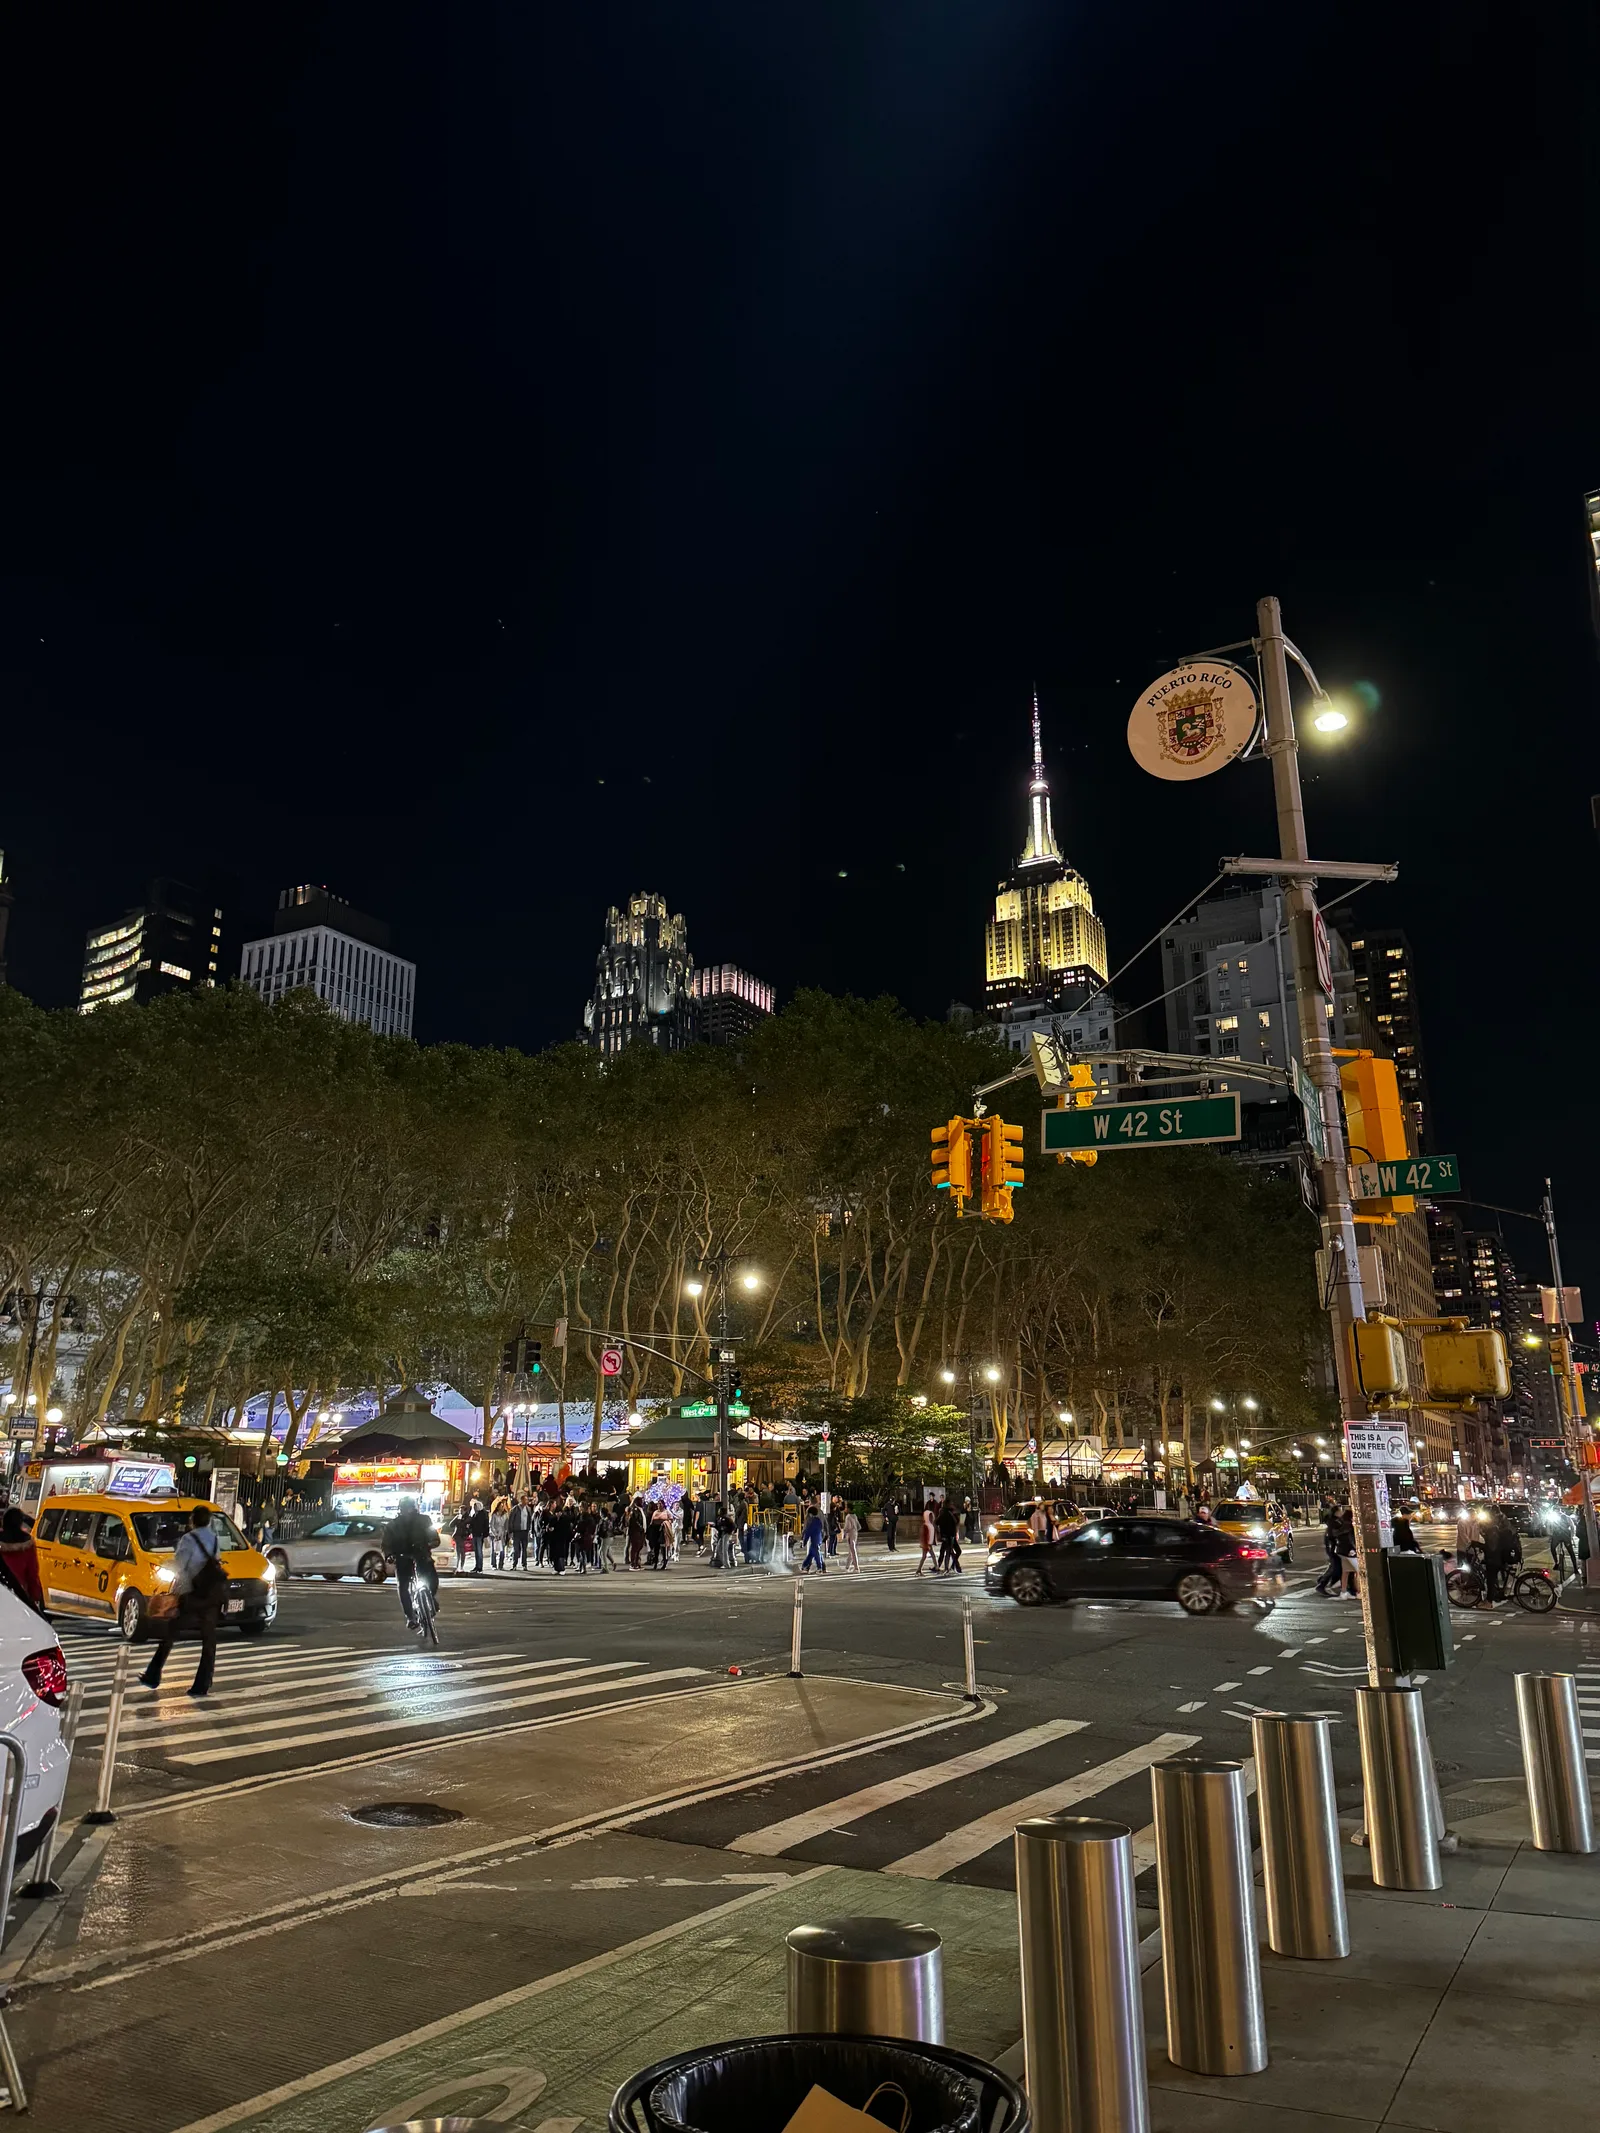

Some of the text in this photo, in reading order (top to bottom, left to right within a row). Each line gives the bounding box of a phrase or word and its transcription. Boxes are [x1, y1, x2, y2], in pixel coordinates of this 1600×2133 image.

[1146, 672, 1232, 707] PUERTO RICO
[1093, 1109, 1183, 1139] W 42 St
[1380, 1161, 1452, 1192] W 42 St
[1584, 1363, 1600, 1372] W 42
[682, 1408, 697, 1416] West
[710, 1407, 716, 1415] St
